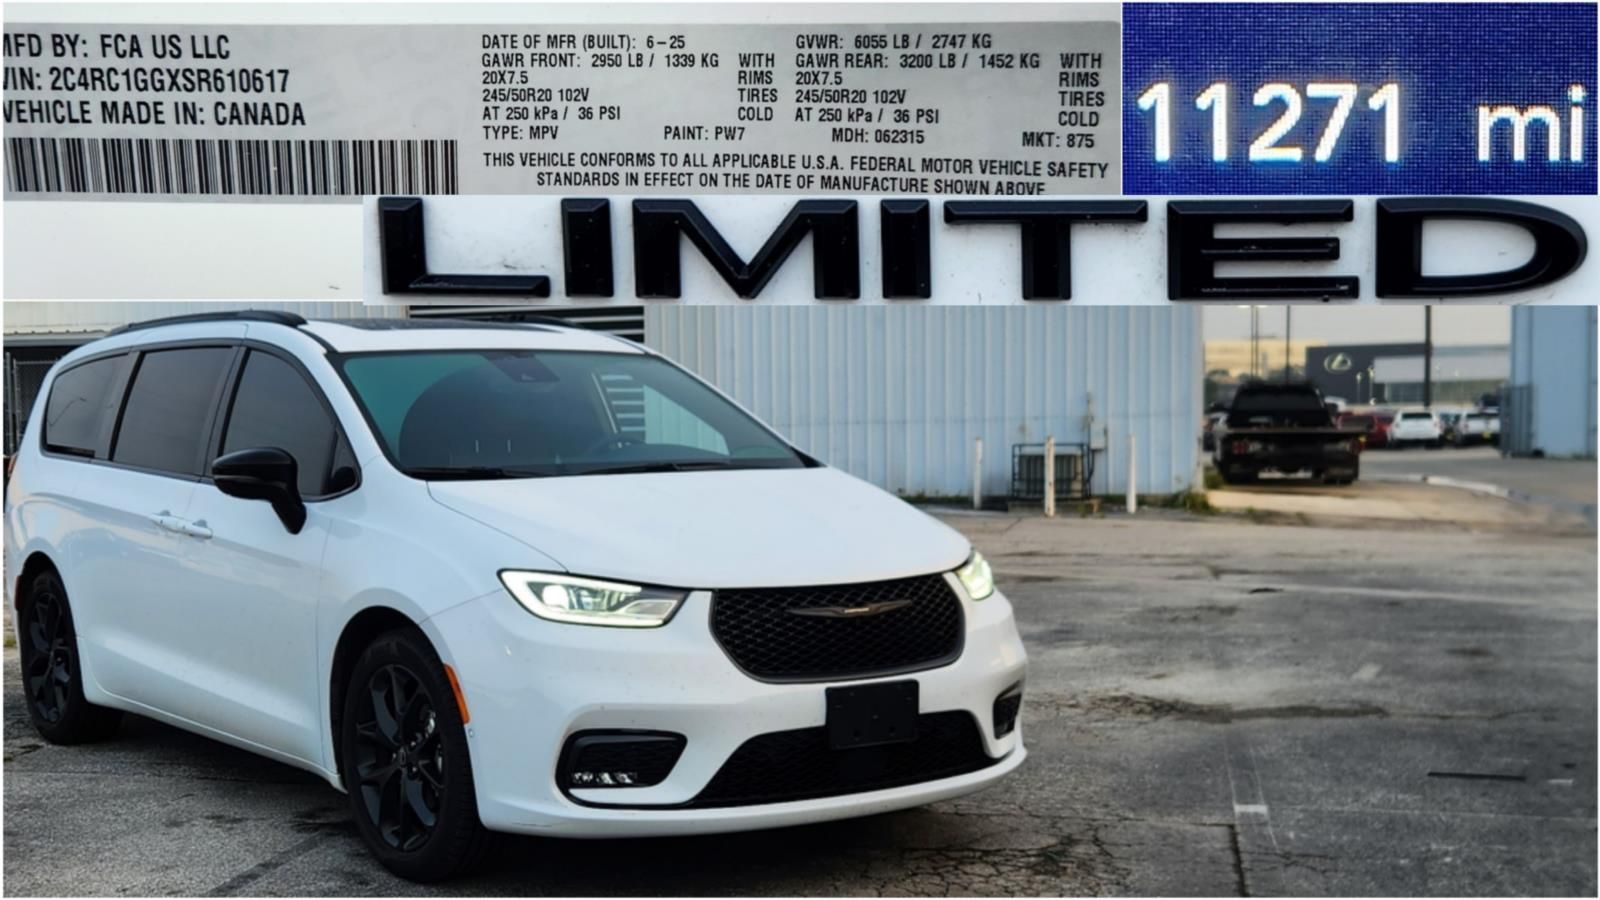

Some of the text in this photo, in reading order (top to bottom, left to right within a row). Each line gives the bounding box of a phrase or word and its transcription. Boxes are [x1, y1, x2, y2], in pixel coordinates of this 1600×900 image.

[51, 34, 88, 57] BY:
[100, 34, 143, 58] FCA
[152, 34, 182, 59] US
[191, 35, 229, 59] LLC
[482, 34, 518, 49] DATE
[523, 34, 540, 49] OF
[547, 35, 576, 48] MFR
[583, 35, 635, 52] (BUILT):
[796, 34, 991, 49] GVWR: 6055 LB / 2747 KG
[482, 53, 718, 67] GAWR FRONT: 2950 LB / 1339 KG
[739, 53, 774, 67] WITH
[796, 53, 1040, 68] GAWR REAR: 3200 LB / 1452 KG
[1060, 53, 1102, 68] WITH
[49, 67, 289, 93] 2C4RC1GGXSR610617
[483, 70, 528, 84] 20X7.5
[738, 70, 772, 85] RIMS
[796, 71, 842, 85] 20X7.5
[1059, 72, 1099, 87] RIMS
[483, 88, 589, 102] 245/50R20 102V
[738, 88, 777, 102] TIRES
[796, 89, 906, 104] 245/50R20 102V
[1058, 91, 1104, 107] TIRES
[4, 100, 305, 125] VEHICLE MADE IN: CANADA
[483, 106, 620, 120] AT 250 kPa / 36 PSI
[738, 107, 773, 121] COLD
[795, 107, 938, 123] AT 250 kPa / 36 PSI
[1058, 111, 1099, 127] COLD
[1137, 82, 1586, 162] 11271 mi
[483, 126, 558, 139] TYPE: MPV
[664, 126, 745, 140] PAINT: PW7
[832, 128, 924, 144] MDH: 062315
[1022, 132, 1094, 148] MKT: 875
[483, 152, 1108, 178] THIS VEHICLE CONFORMS TO ALL APPLICABLE U.S.A. FEDERAL MOTOR VEHICLE SAFETY
[537, 172, 1045, 194] STANDARDS IN EFFECT ON THE DATE OF MANUFACTURE SHOWN ABOVE
[378, 197, 1588, 301] LIMITED
